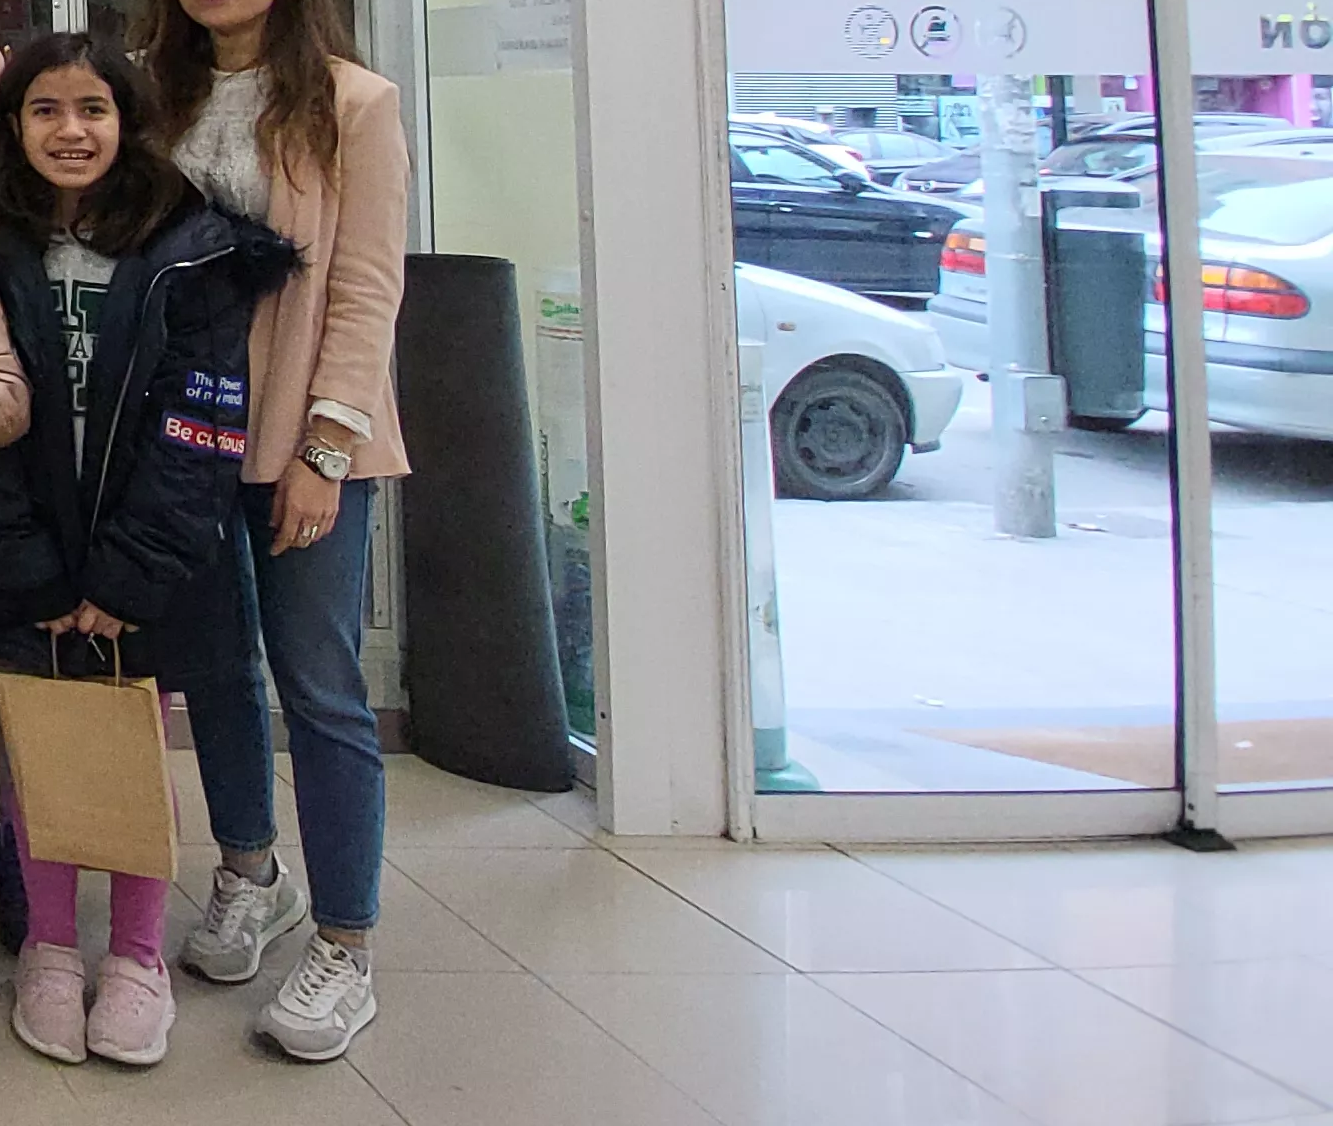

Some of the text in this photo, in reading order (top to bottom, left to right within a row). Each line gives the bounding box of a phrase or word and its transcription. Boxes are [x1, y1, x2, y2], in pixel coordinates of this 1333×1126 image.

[186, 387, 201, 399] of
[165, 417, 245, 454] Be curious
